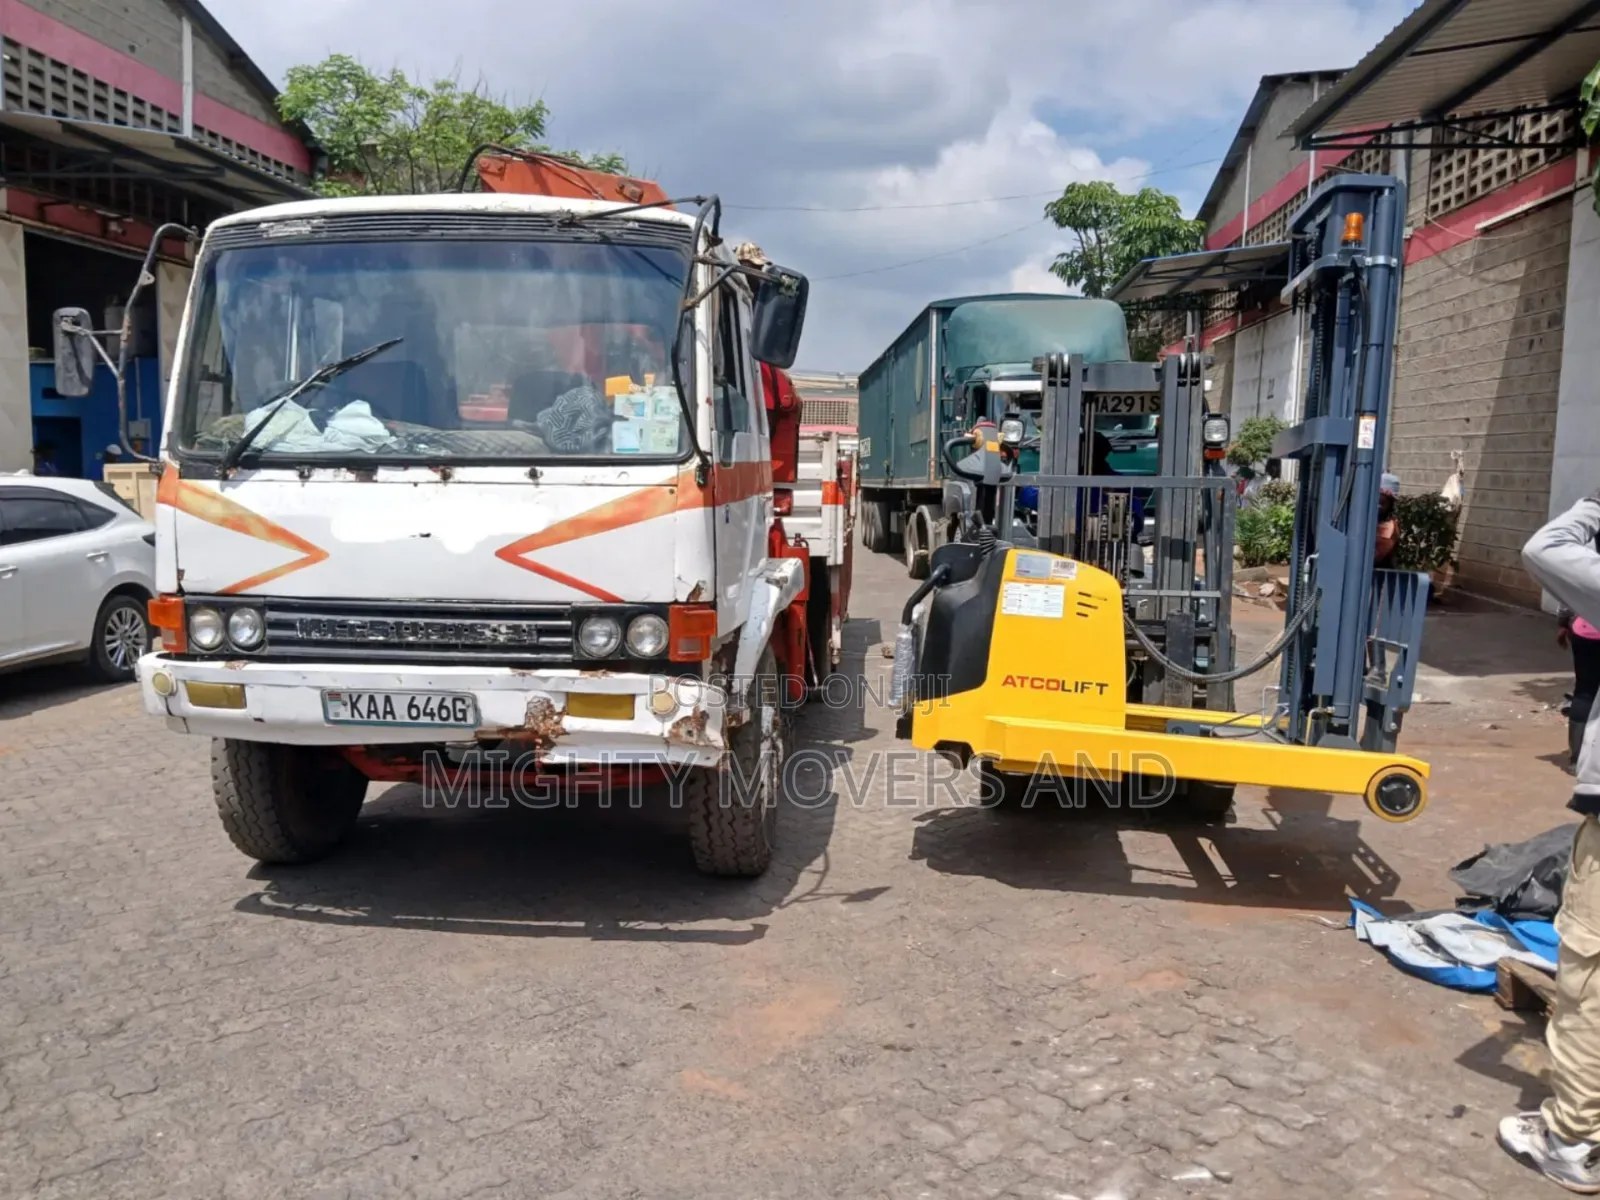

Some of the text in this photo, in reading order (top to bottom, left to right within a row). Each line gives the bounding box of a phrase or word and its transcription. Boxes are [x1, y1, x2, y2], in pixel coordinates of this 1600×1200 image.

[1002, 674, 1109, 696] ATCOLIFT
[349, 693, 468, 722] KAA 646G
